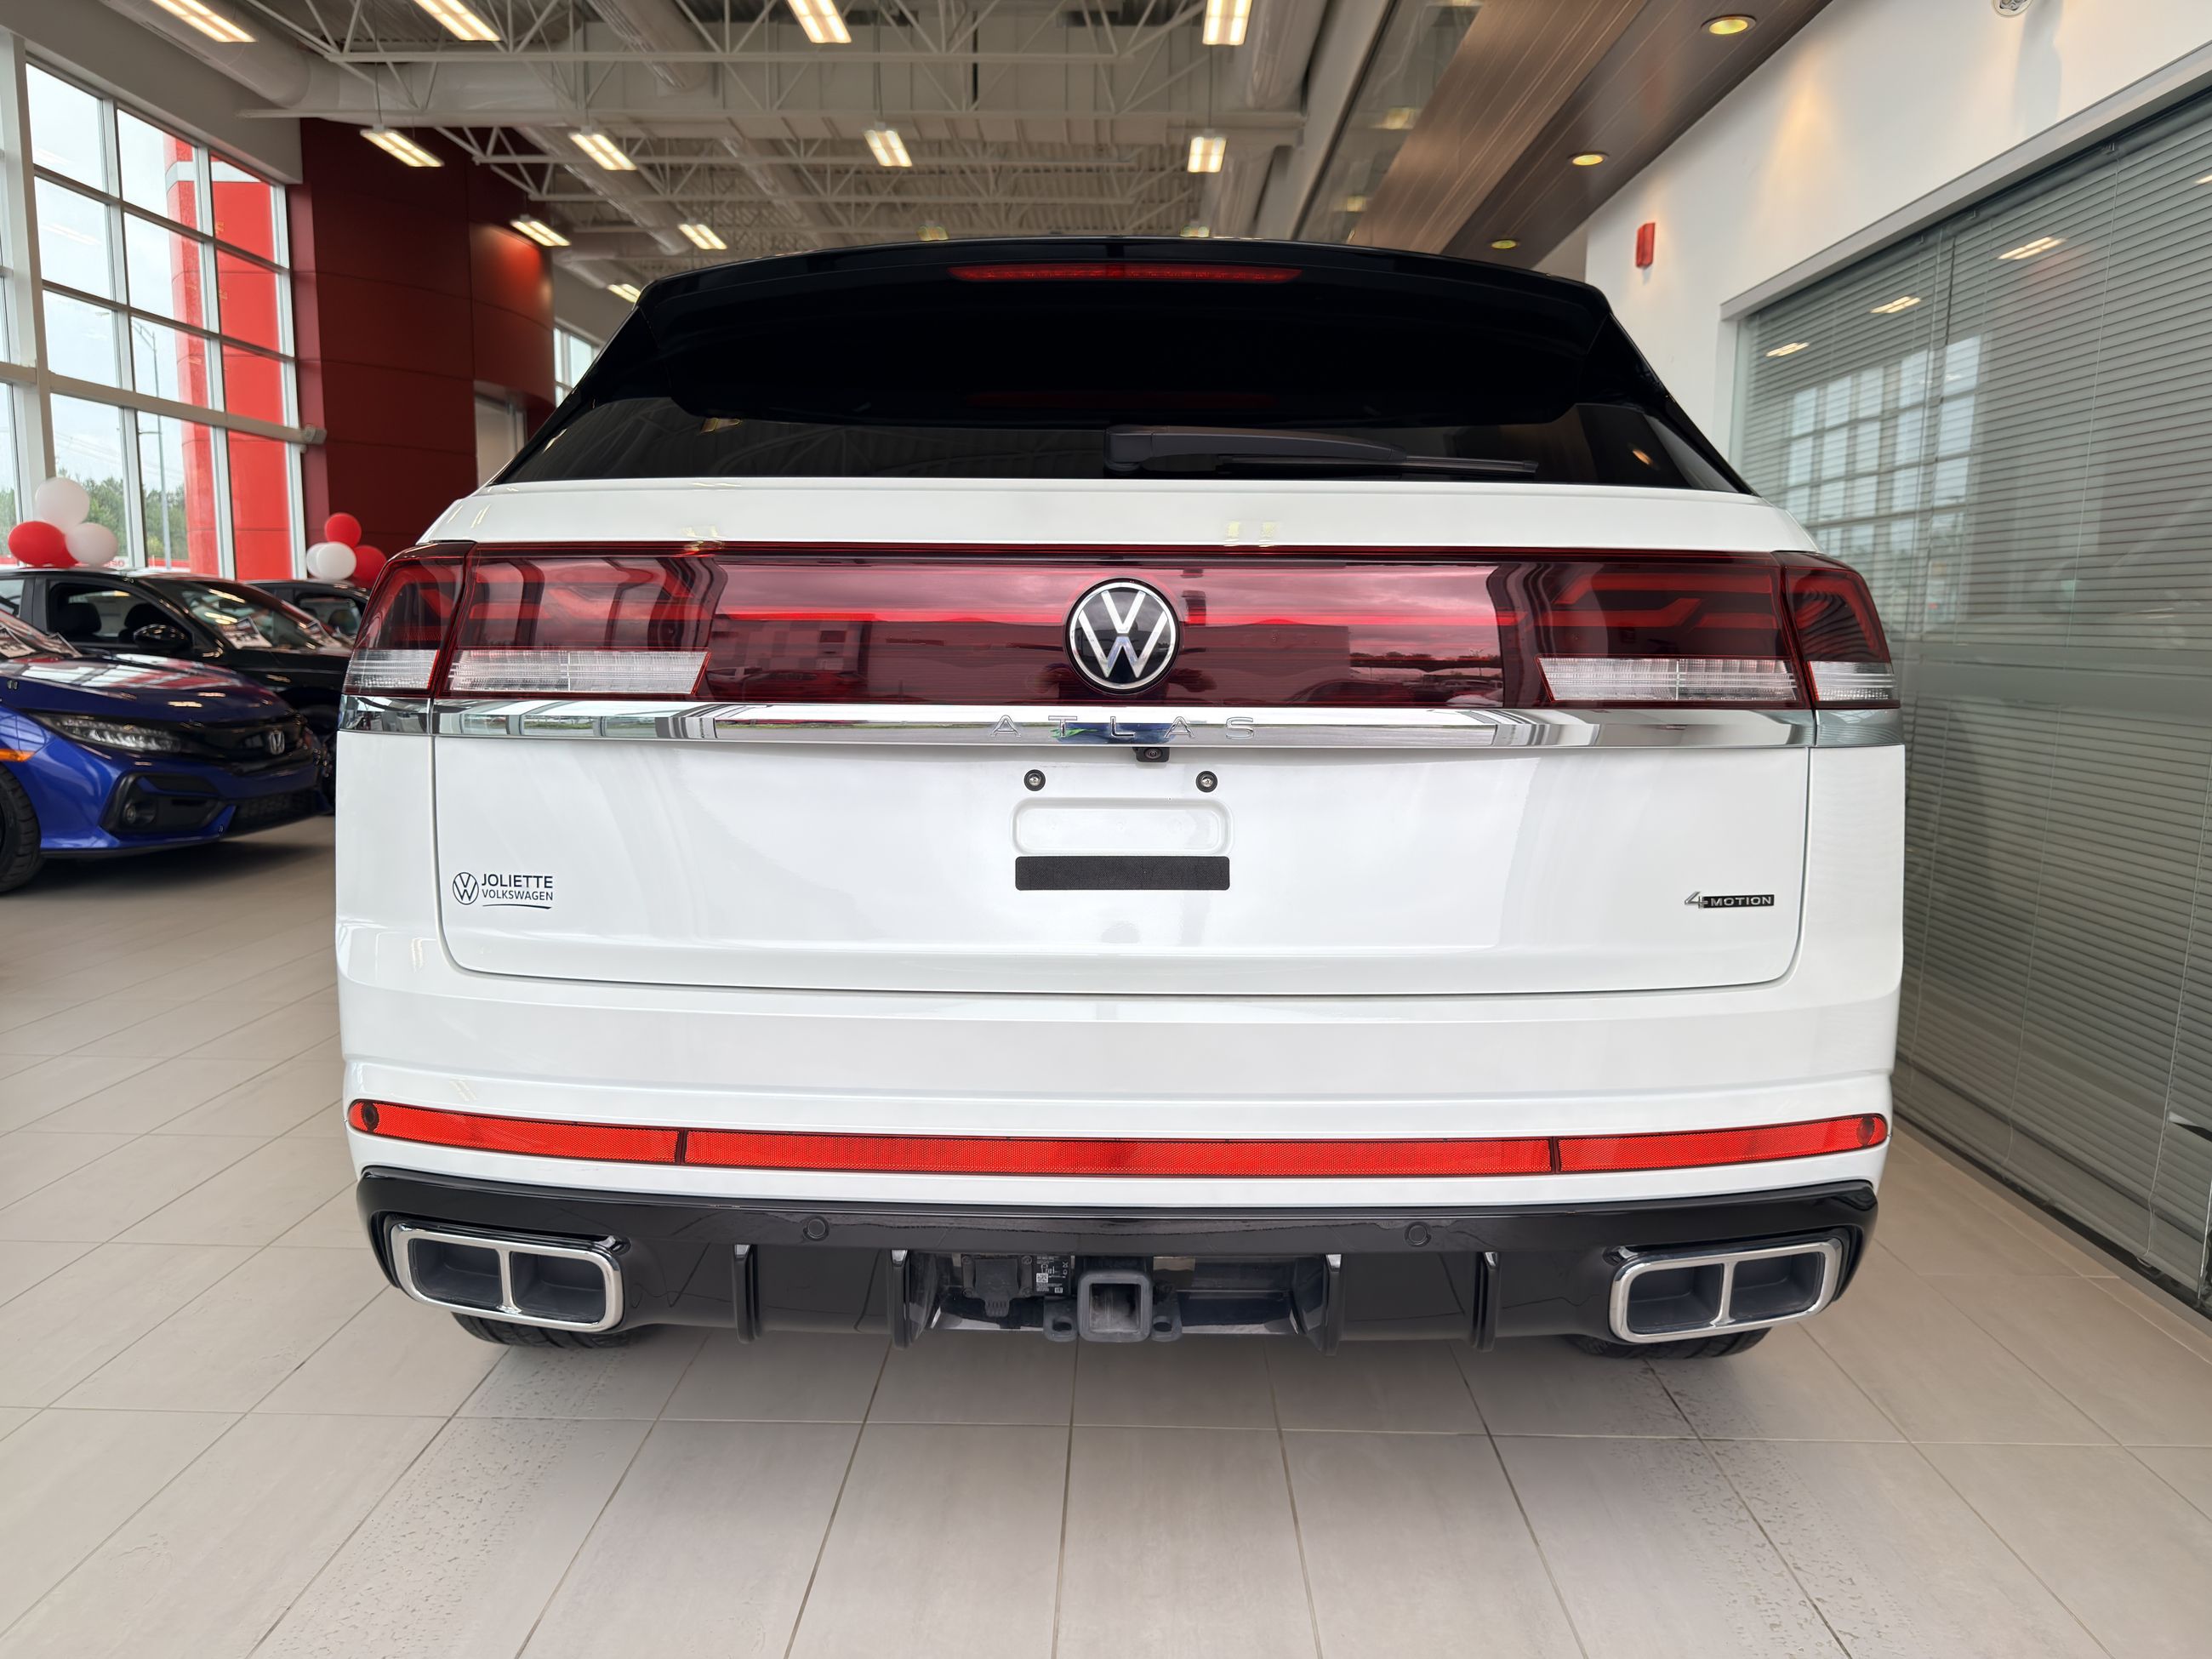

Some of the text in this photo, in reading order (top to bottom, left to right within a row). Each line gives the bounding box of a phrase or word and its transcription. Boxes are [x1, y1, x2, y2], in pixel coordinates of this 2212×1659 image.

[1074, 585, 1172, 682] VW
[989, 714, 1256, 740] ATLAS
[482, 873, 553, 889] JOLIETTE
[482, 888, 553, 901] VOLKSWAGEN
[1684, 891, 1772, 909] 4MOTION
